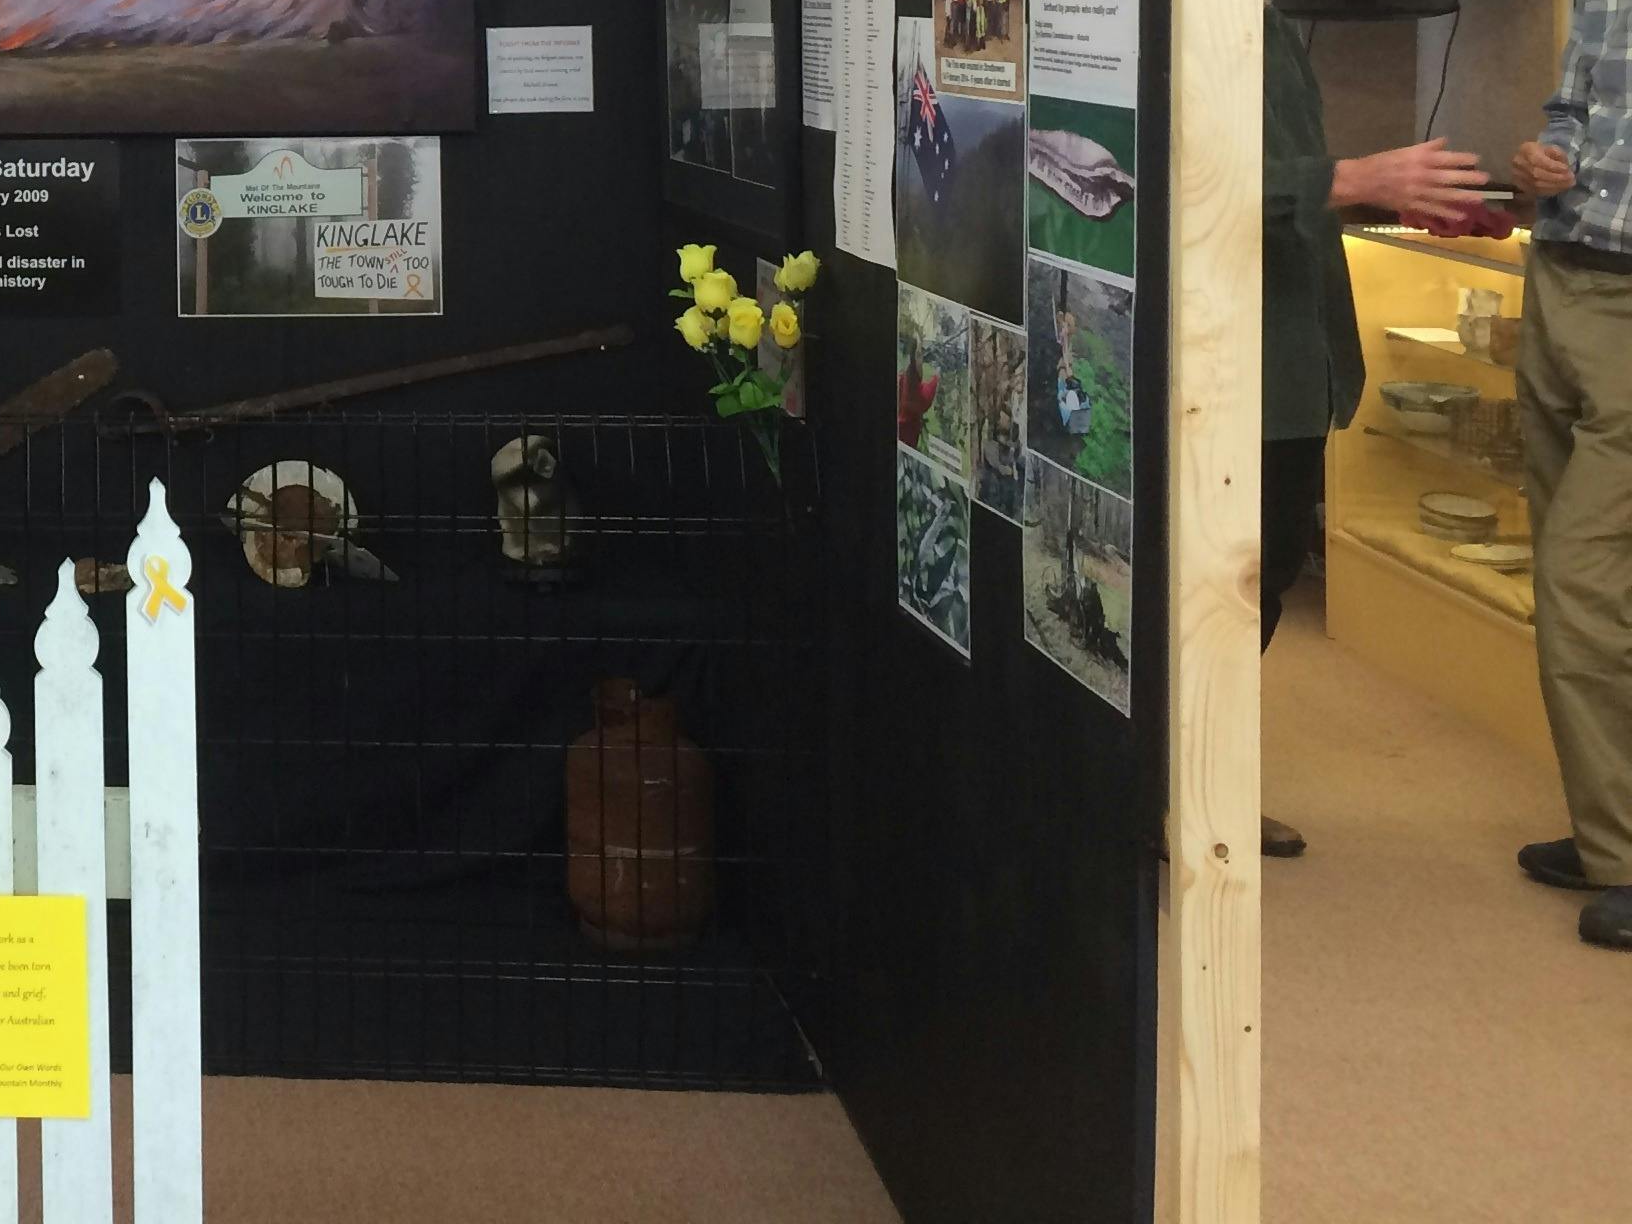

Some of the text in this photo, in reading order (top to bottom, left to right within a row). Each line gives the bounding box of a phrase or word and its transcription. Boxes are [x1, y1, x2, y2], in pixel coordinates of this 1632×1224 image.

[14, 190, 49, 202] 2009
[240, 192, 325, 202] Welcome to
[247, 204, 318, 214] KINGLAKE
[6, 225, 39, 237] Lost
[316, 222, 428, 248] KINGLAKE
[7, 256, 67, 268] disaster
[72, 256, 85, 268] in
[319, 248, 429, 271] THE TOWN STILL TOO
[318, 274, 398, 289] TOUGH TO DIE
[16, 936, 26, 944] as
[29, 936, 34, 944] a
[8, 960, 29, 971] been
[31, 962, 51, 971] torn
[3, 988, 20, 998] and
[7, 1015, 55, 1026] Australian
[29, 1079, 62, 1089] Monthly
